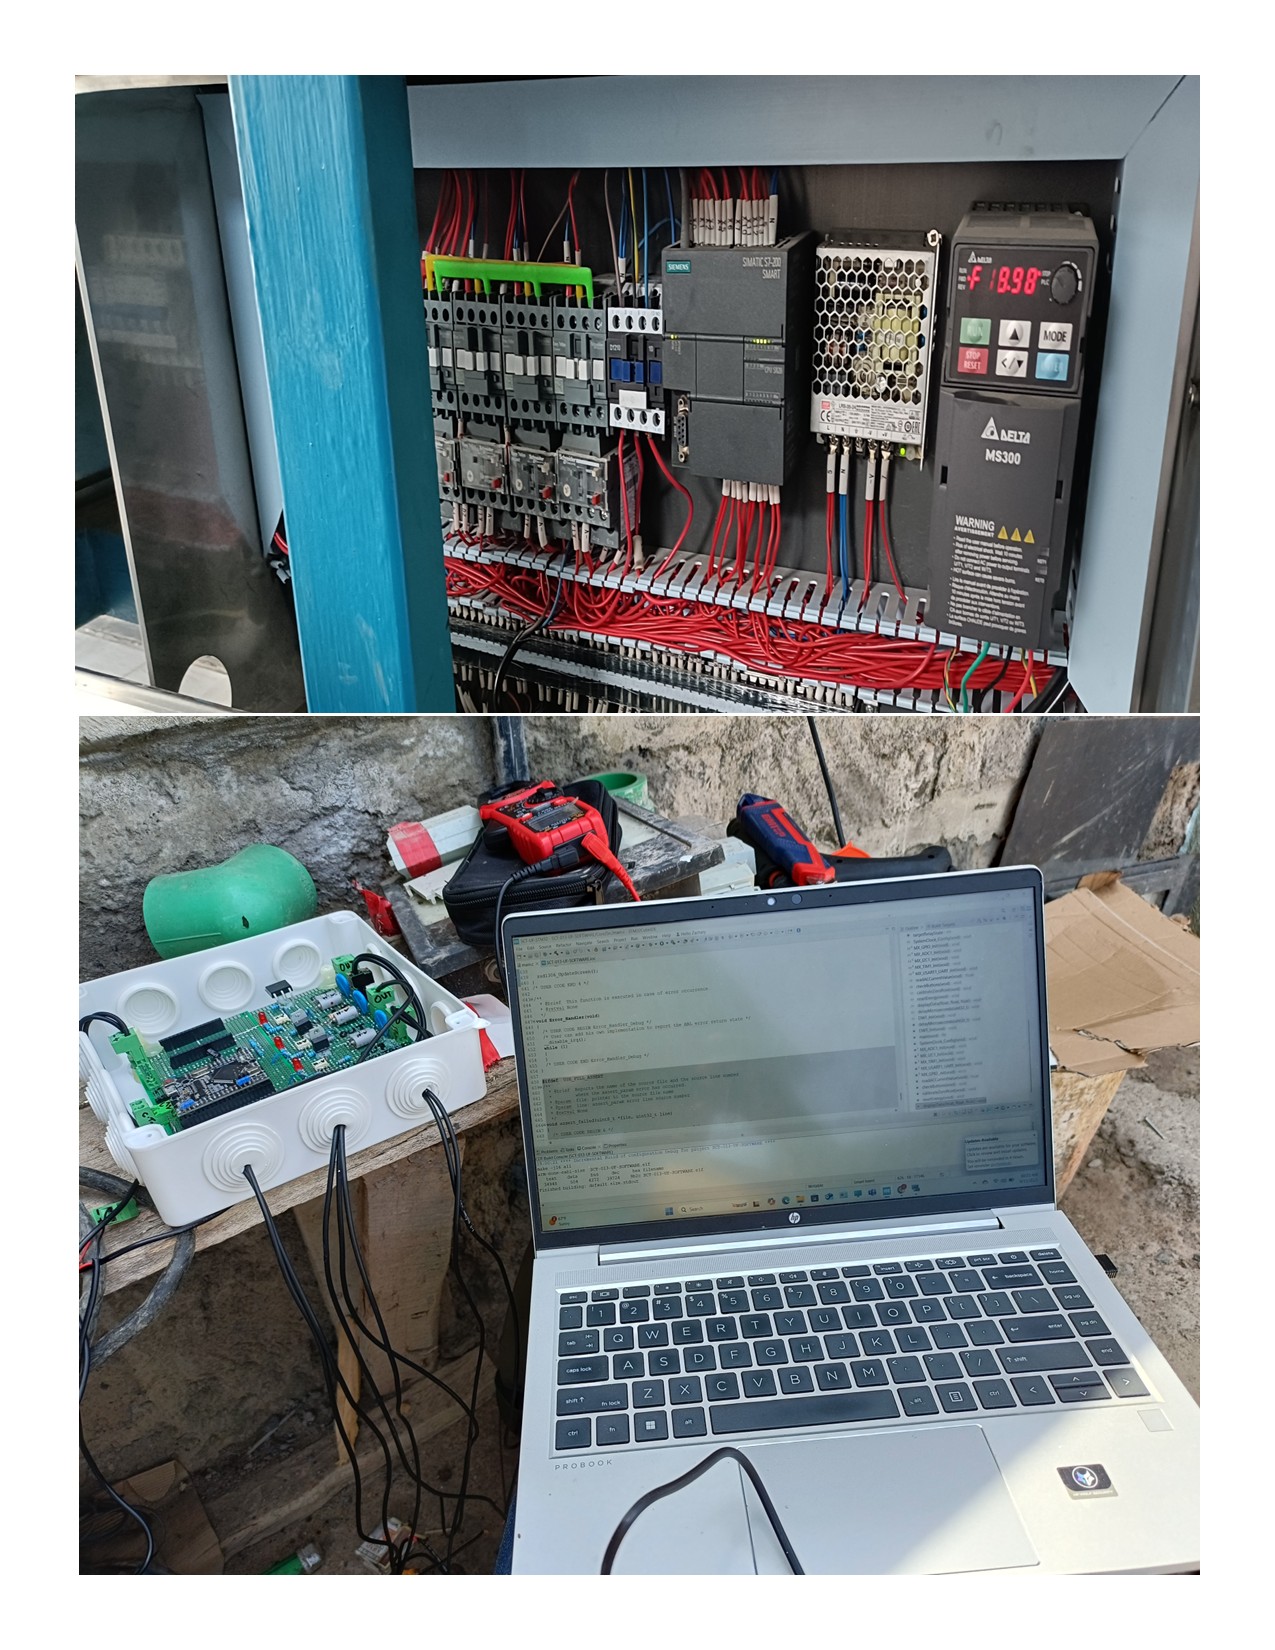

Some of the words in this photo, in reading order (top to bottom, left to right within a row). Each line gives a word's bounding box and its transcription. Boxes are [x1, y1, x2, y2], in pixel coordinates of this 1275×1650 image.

[668, 263, 689, 271] SIEMENS
[742, 257, 764, 267] SIMATIC
[764, 257, 782, 268] S7-200
[762, 269, 781, 279] SMART
[1043, 330, 1067, 342] MODE
[965, 351, 981, 361] STOP
[963, 360, 982, 370] RESET
[1000, 429, 1030, 444] DELTA
[985, 448, 1021, 465] MS300
[955, 514, 995, 532] WARNING
[374, 991, 392, 1003] OUT
[789, 1212, 800, 1224] hp
[829, 1288, 837, 1296] 8
[862, 1285, 870, 1293] 9
[763, 1294, 770, 1302] 6
[796, 1291, 803, 1299] 7
[730, 1297, 736, 1305] 5
[630, 1307, 637, 1315] 2
[664, 1303, 670, 1311] 3
[922, 1305, 932, 1314] P
[888, 1308, 899, 1318] O
[785, 1318, 794, 1326] Y
[819, 1315, 829, 1323] U
[717, 1324, 726, 1333] R
[751, 1321, 759, 1329] T
[645, 1330, 659, 1339] W
[682, 1327, 691, 1336] E
[613, 1334, 623, 1342] Q
[871, 1337, 883, 1346] K
[908, 1334, 917, 1343] L
[801, 1344, 812, 1353] H
[838, 1341, 846, 1350] J
[730, 1350, 738, 1359] F
[765, 1347, 776, 1356] G
[659, 1357, 668, 1366] S
[694, 1354, 704, 1363] D
[566, 1366, 579, 1374] caps
[623, 1361, 634, 1370] A
[826, 1371, 838, 1381] N
[863, 1368, 875, 1377] M
[752, 1378, 763, 1387] V
[790, 1375, 800, 1385] B
[680, 1385, 690, 1394] X
[716, 1381, 727, 1391] C
[644, 1389, 652, 1398] Z
[554, 1459, 612, 1470] PROBOOK
